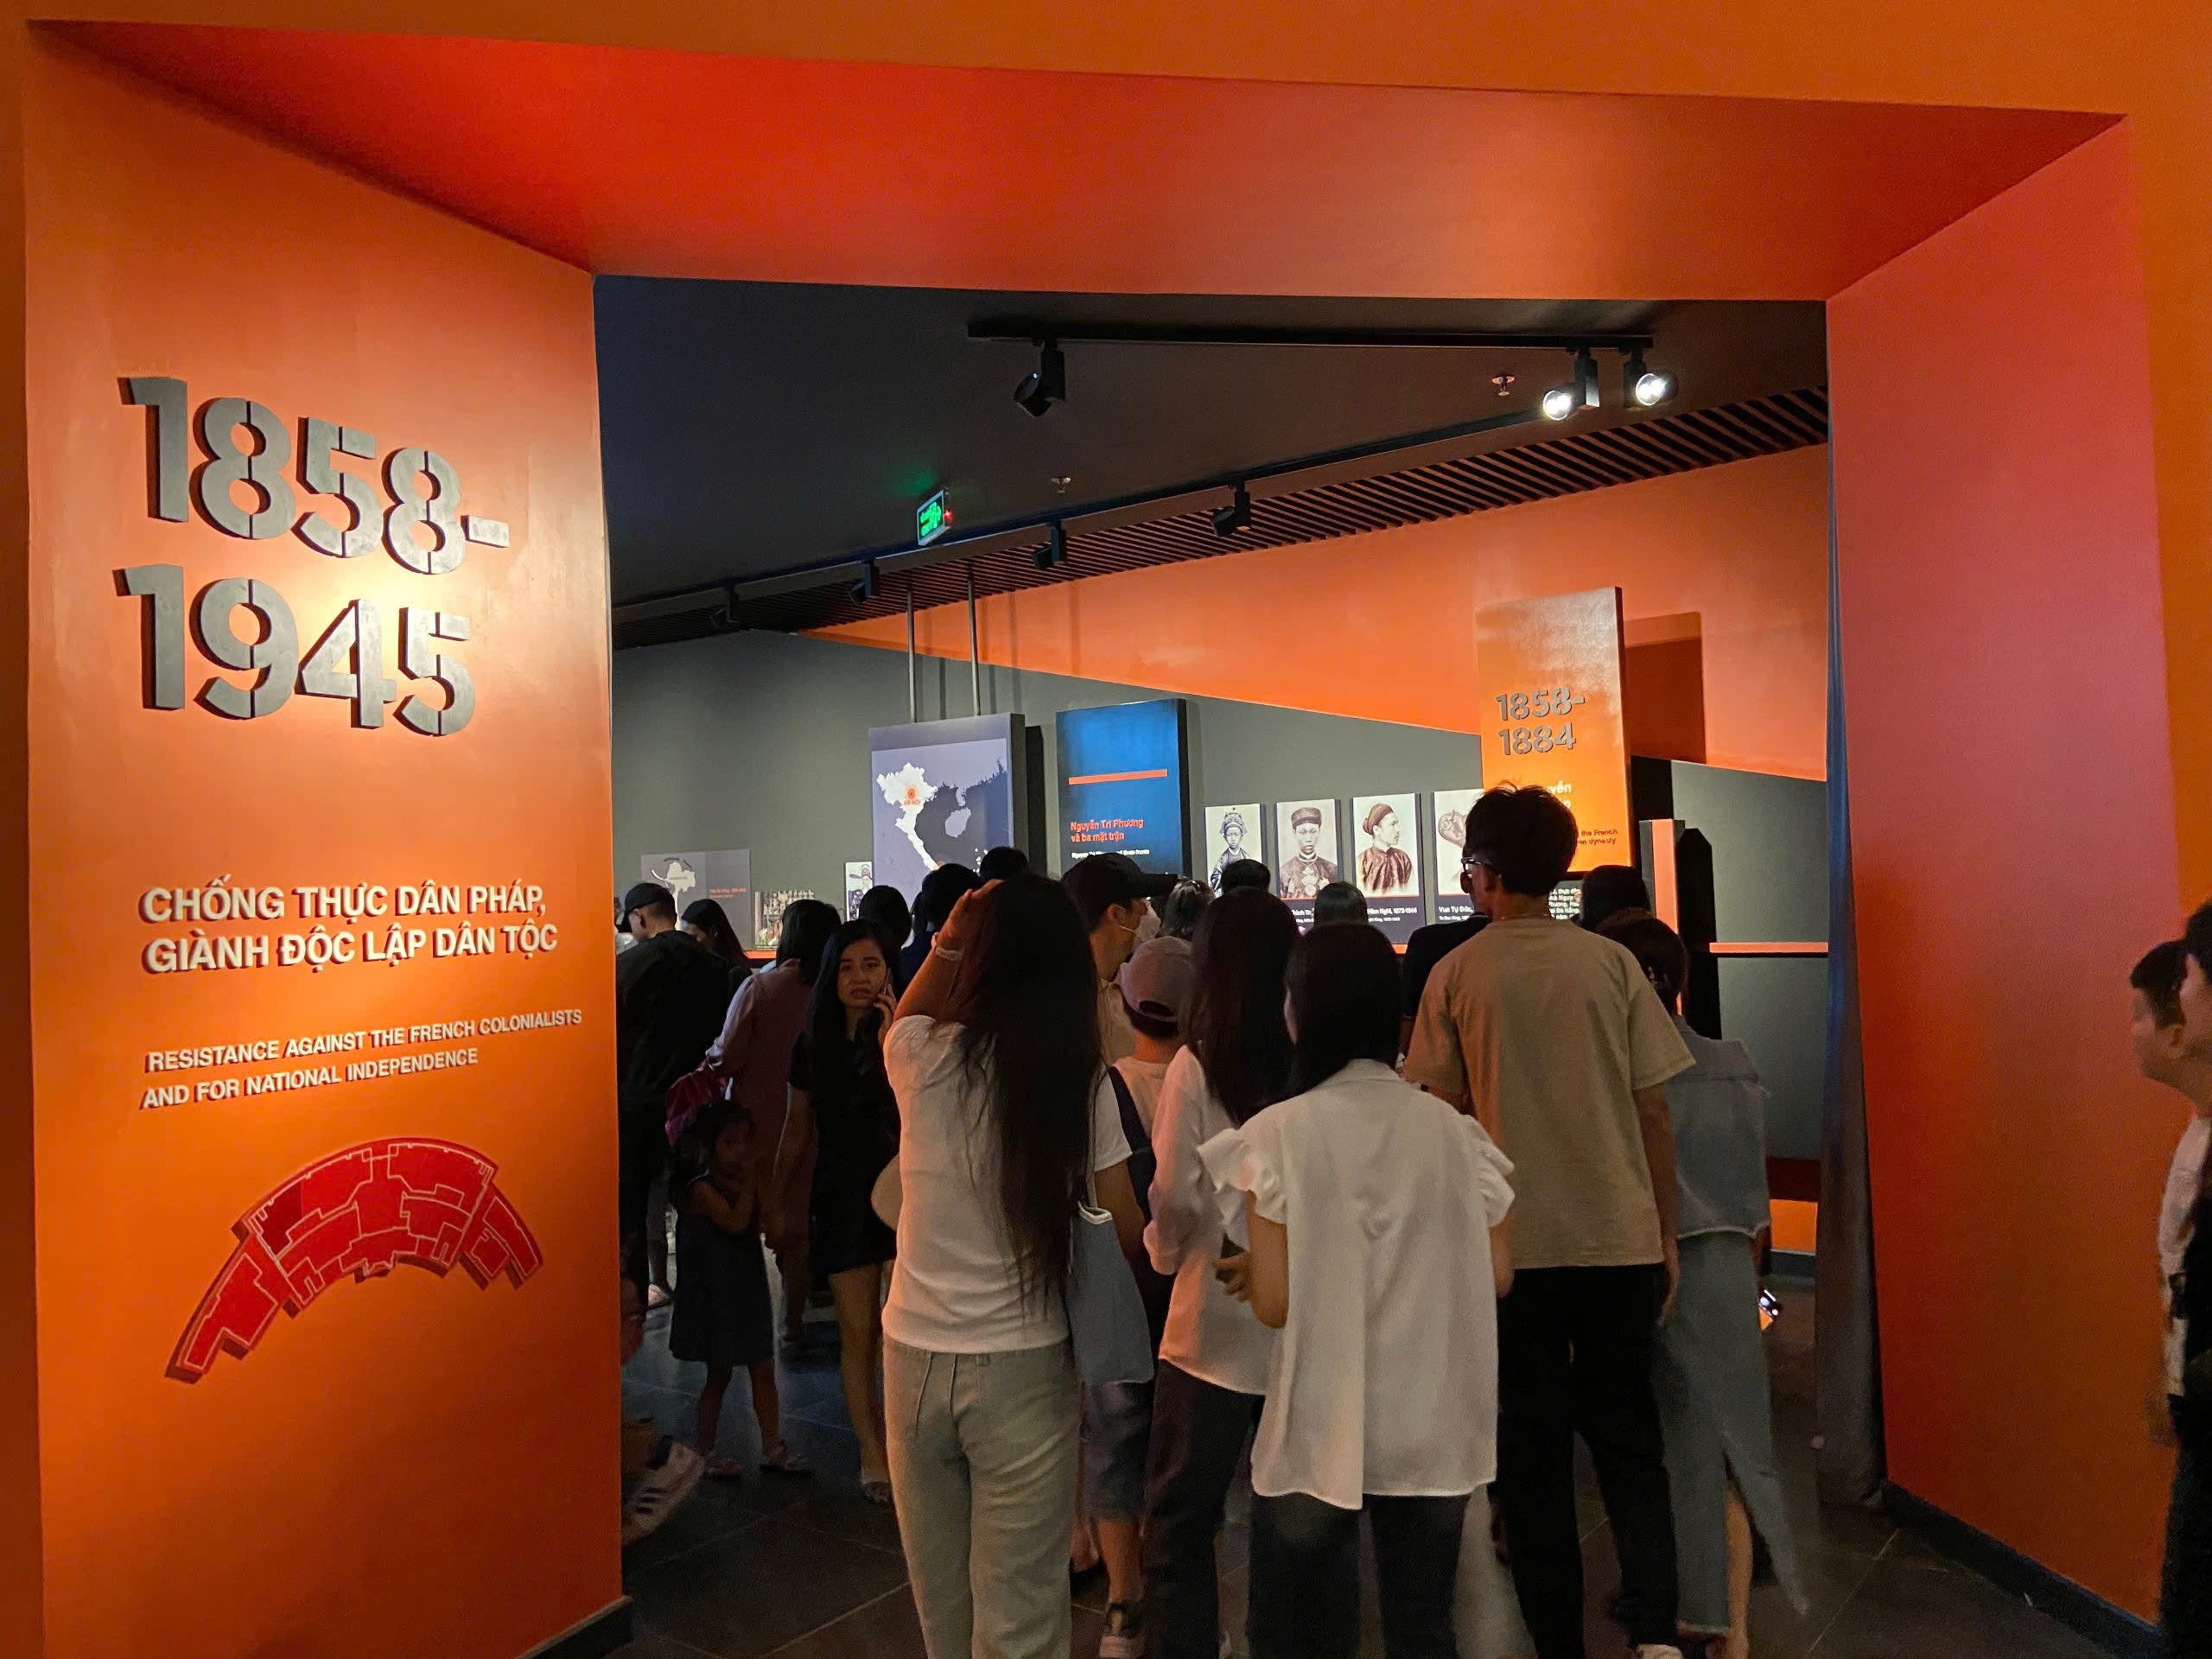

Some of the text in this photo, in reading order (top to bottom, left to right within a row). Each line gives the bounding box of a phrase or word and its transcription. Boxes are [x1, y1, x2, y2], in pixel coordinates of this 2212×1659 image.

[118, 377, 510, 575] 1858-
[113, 563, 476, 737] 1945
[1496, 687, 1586, 721] 1858-
[1498, 721, 1576, 755] 1884
[1071, 820, 1099, 832] Nguyễn
[1071, 833, 1080, 842] và
[1081, 833, 1091, 842] ba
[140, 874, 546, 925] CHỐNG THỰC DÂN PHÁP,
[143, 918, 558, 974] GIÀNH ĐỘC LẬP DÂN TỘC
[145, 1009, 582, 1073] RESISTANCE AGAINST THE FRENCH COLONIALISTS
[139, 1047, 478, 1109] AND FOR NATIONAL INDEPENDENCE
